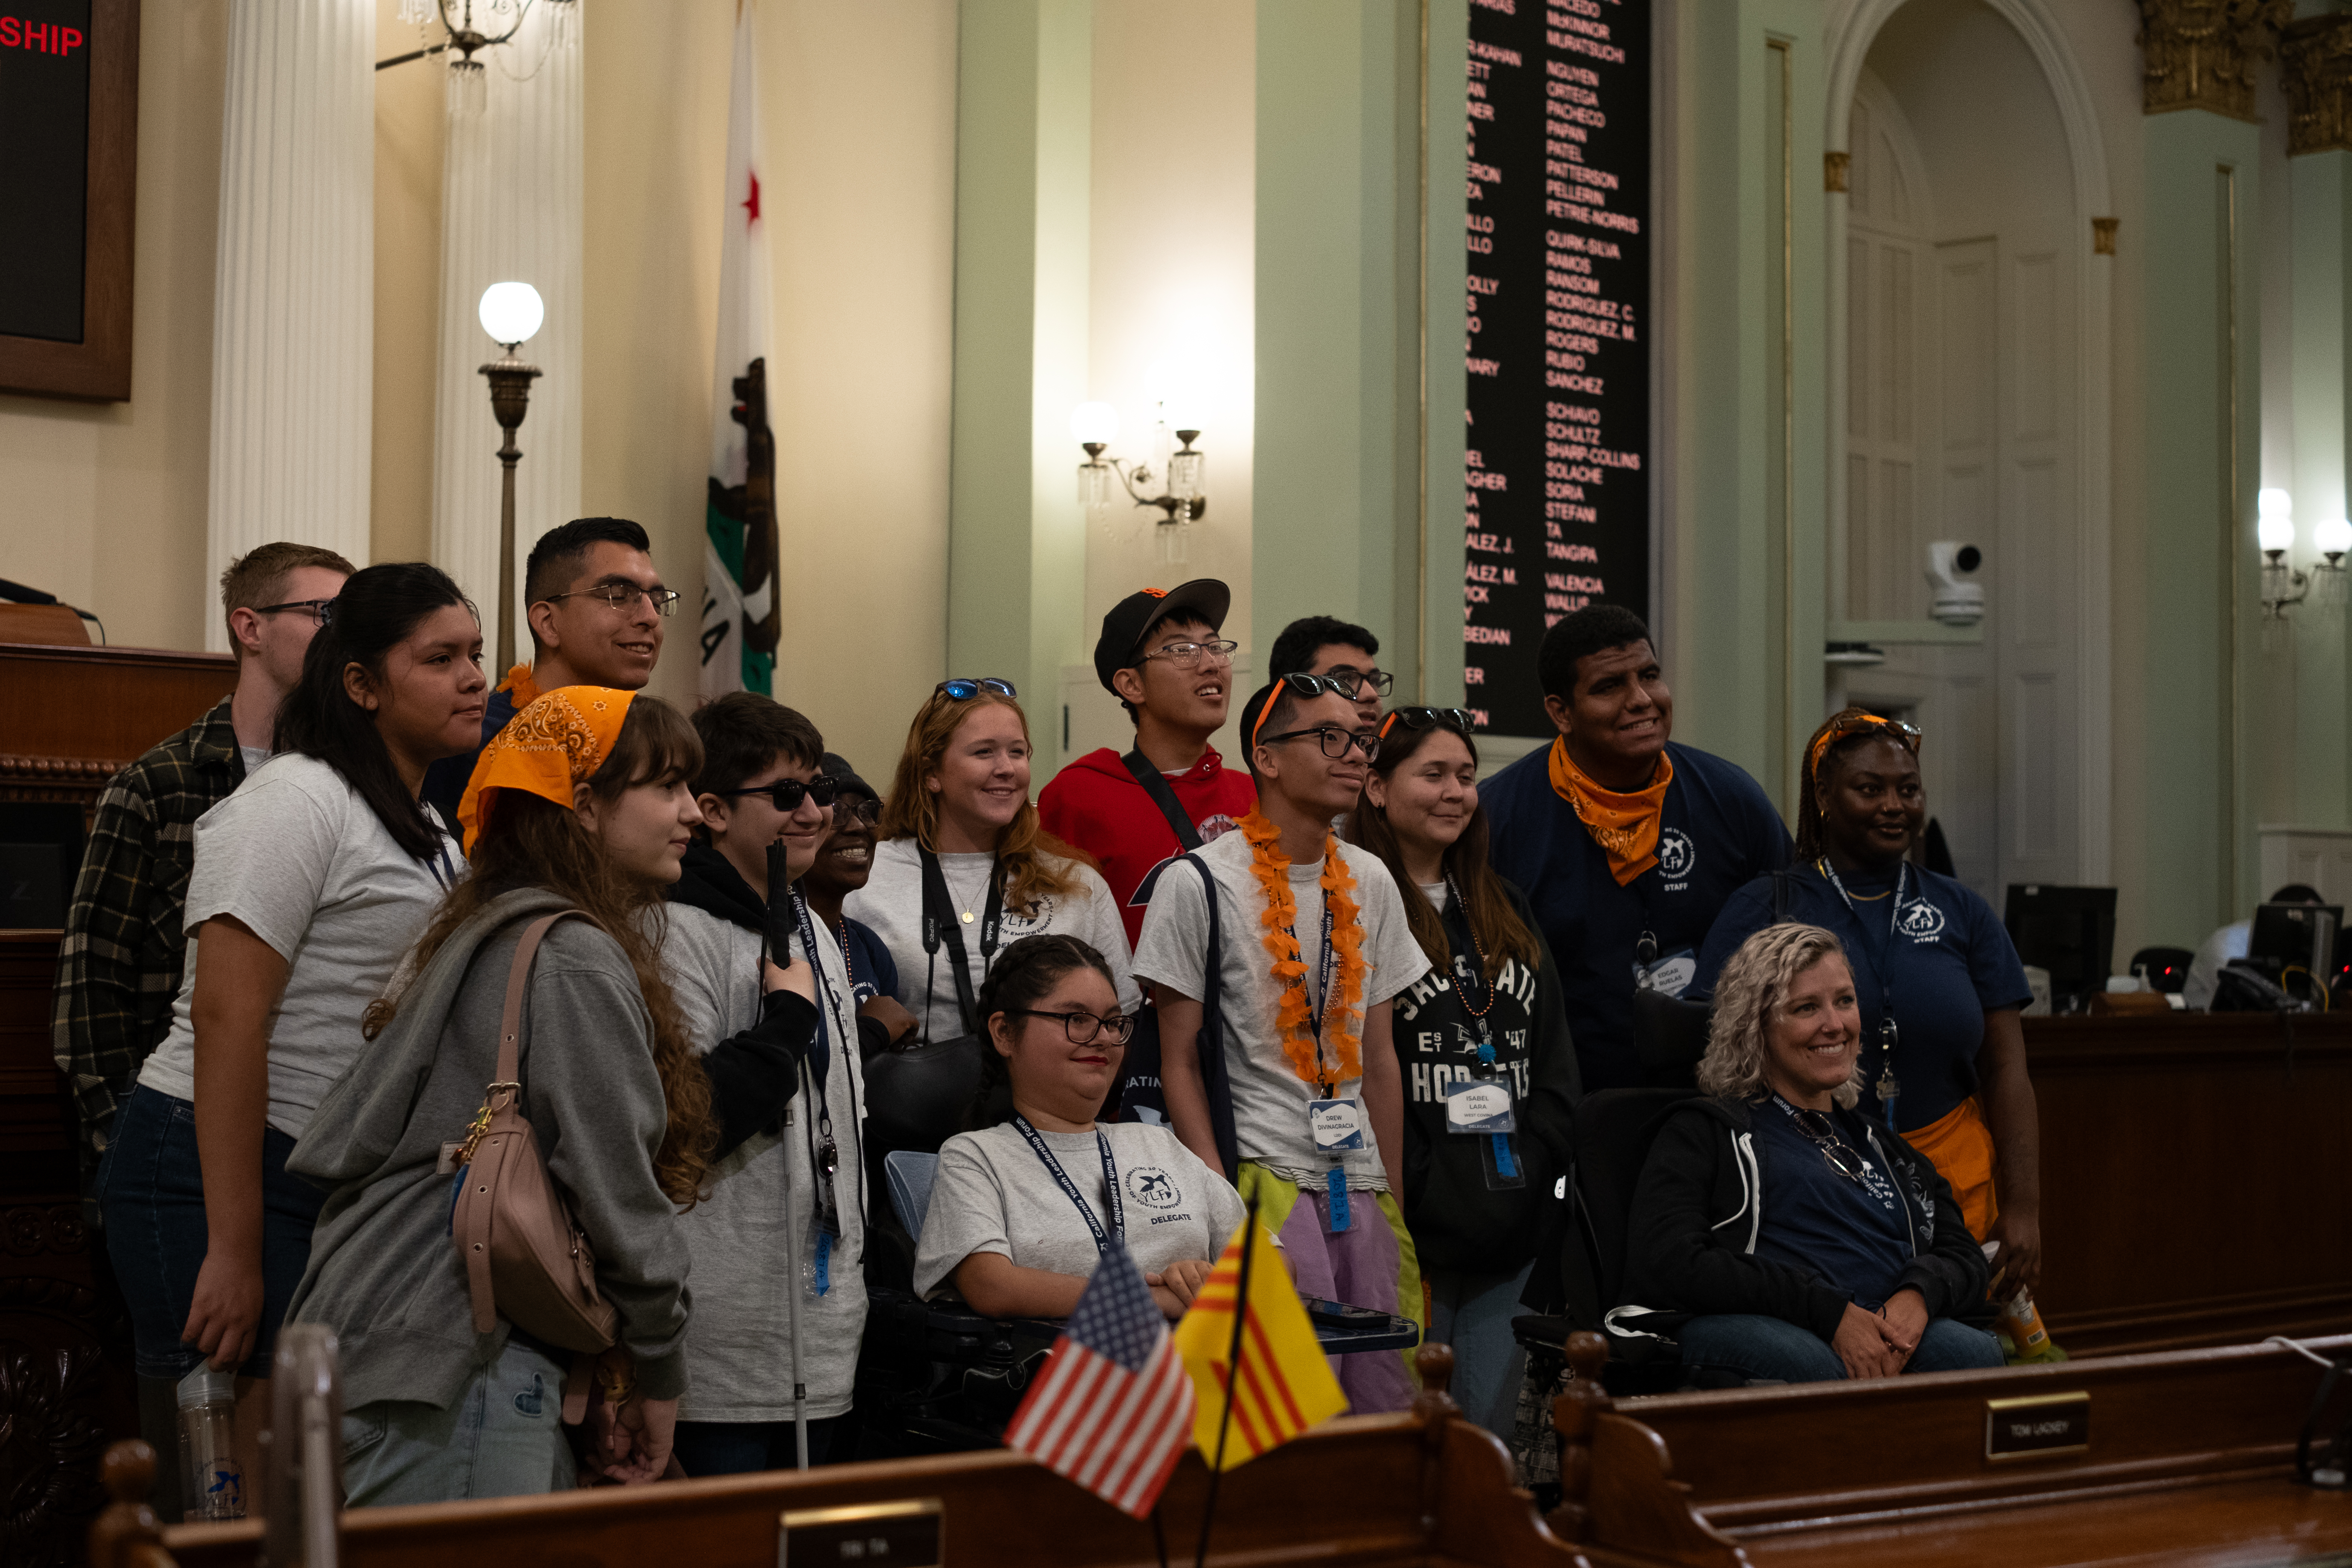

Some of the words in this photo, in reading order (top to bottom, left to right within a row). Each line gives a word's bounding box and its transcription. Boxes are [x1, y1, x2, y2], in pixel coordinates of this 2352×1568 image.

[0, 16, 83, 56] SHIP
[1546, 521, 1563, 539] TA
[1664, 882, 1688, 892] STAFF
[793, 895, 814, 948] Leadership
[986, 921, 994, 942] Kodak
[1010, 914, 1053, 936] EMPOWERMENT
[1321, 942, 1330, 983] California
[1658, 968, 1678, 978] EDGAR
[1659, 975, 1683, 986] RUELAS
[1505, 1029, 1526, 1050] '47
[1772, 1095, 1795, 1116] Forum
[1016, 1116, 1034, 1138] Forum
[1032, 1136, 1063, 1177] Leadership
[1106, 1158, 1115, 1179] Youth
[1125, 1167, 1147, 1187] CELEBRATING
[1061, 1176, 1079, 1199] Youth
[1136, 1199, 1158, 1209] YOUTH
[1160, 1187, 1181, 1209] EMPOWERMENT
[1110, 1180, 1122, 1223] Leadership
[1078, 1199, 1102, 1238] California
[1150, 1214, 1192, 1225] DELEGATE
